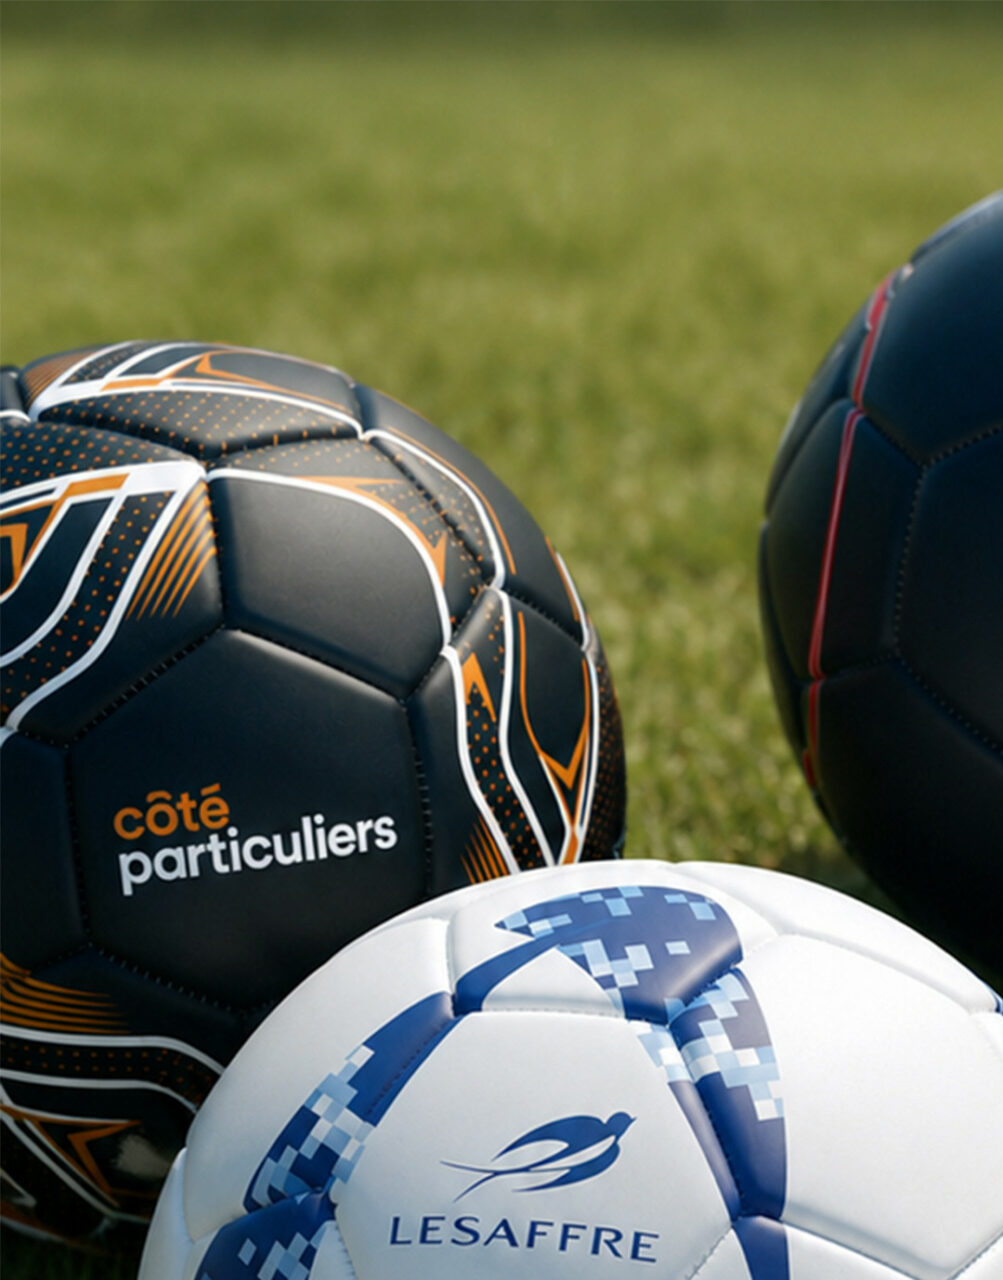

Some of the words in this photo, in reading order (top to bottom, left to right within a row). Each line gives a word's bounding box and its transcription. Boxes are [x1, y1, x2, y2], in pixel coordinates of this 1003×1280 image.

[113, 783, 230, 840] côté
[119, 814, 398, 896] particuliers
[389, 1215, 661, 1264] LESAFFRE
